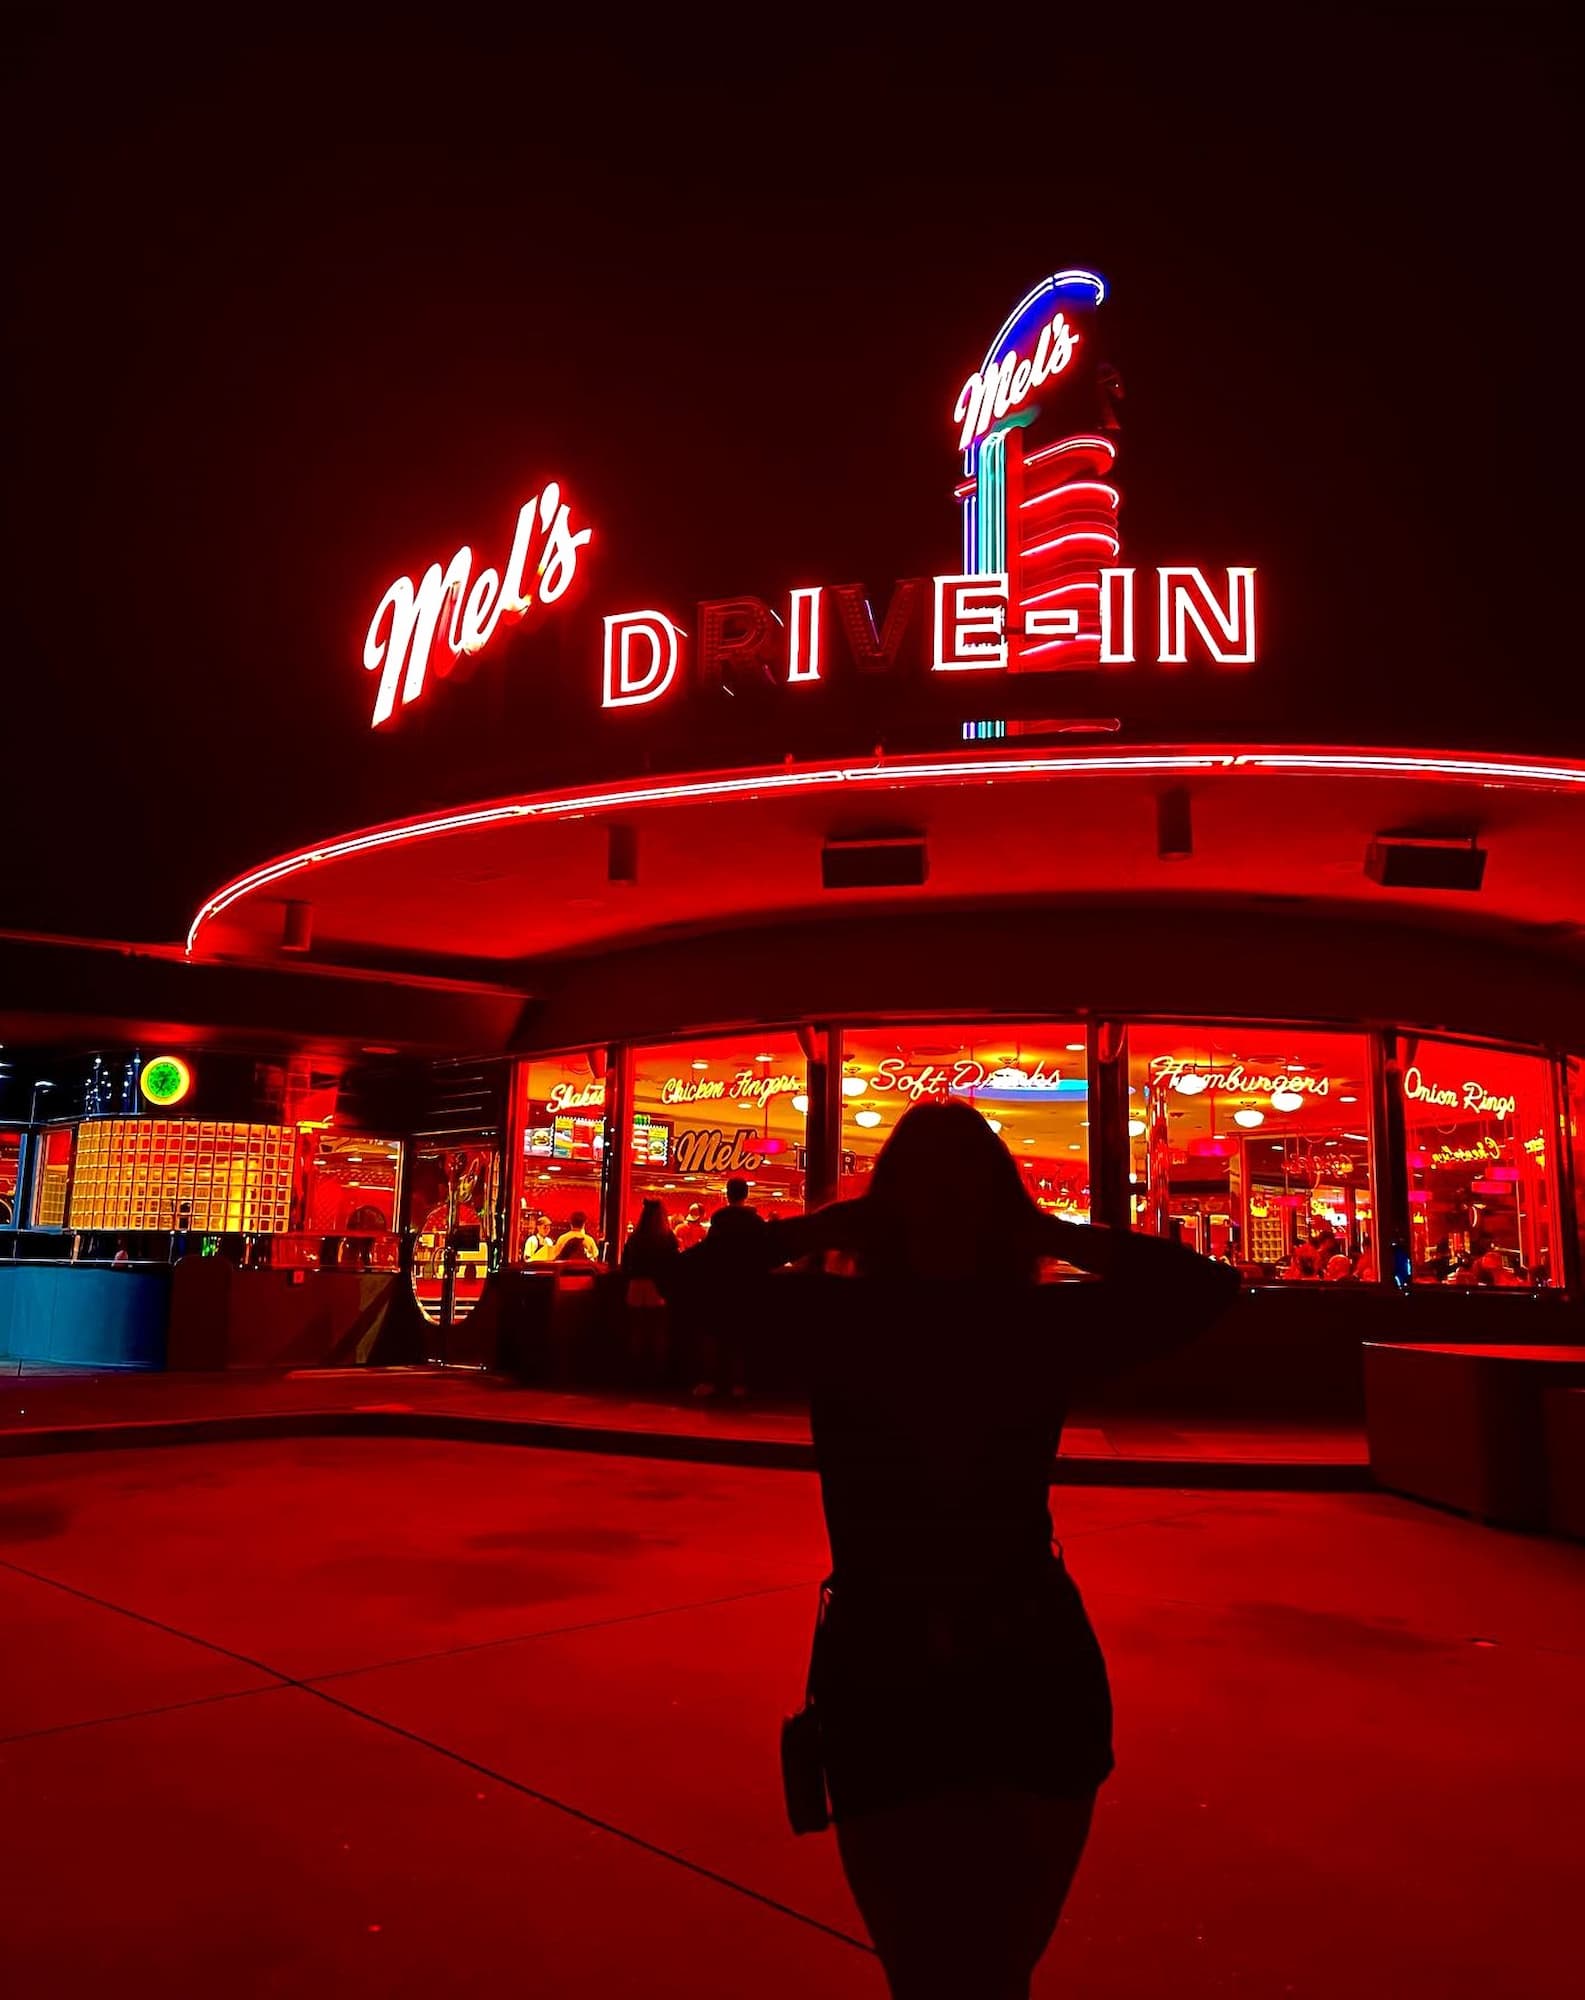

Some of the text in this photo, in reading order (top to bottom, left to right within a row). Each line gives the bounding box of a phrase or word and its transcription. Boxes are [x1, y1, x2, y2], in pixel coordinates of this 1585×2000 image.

[952, 312, 1079, 451] Mel's
[363, 482, 592, 728] Mel's
[602, 567, 1257, 708] DRIVE-IN
[661, 1070, 801, 1108] Chicken Fingers
[870, 1058, 1061, 1100] Soft Drks
[1150, 1055, 1329, 1096] Hmburgers
[1404, 1067, 1516, 1121] Onion Rings
